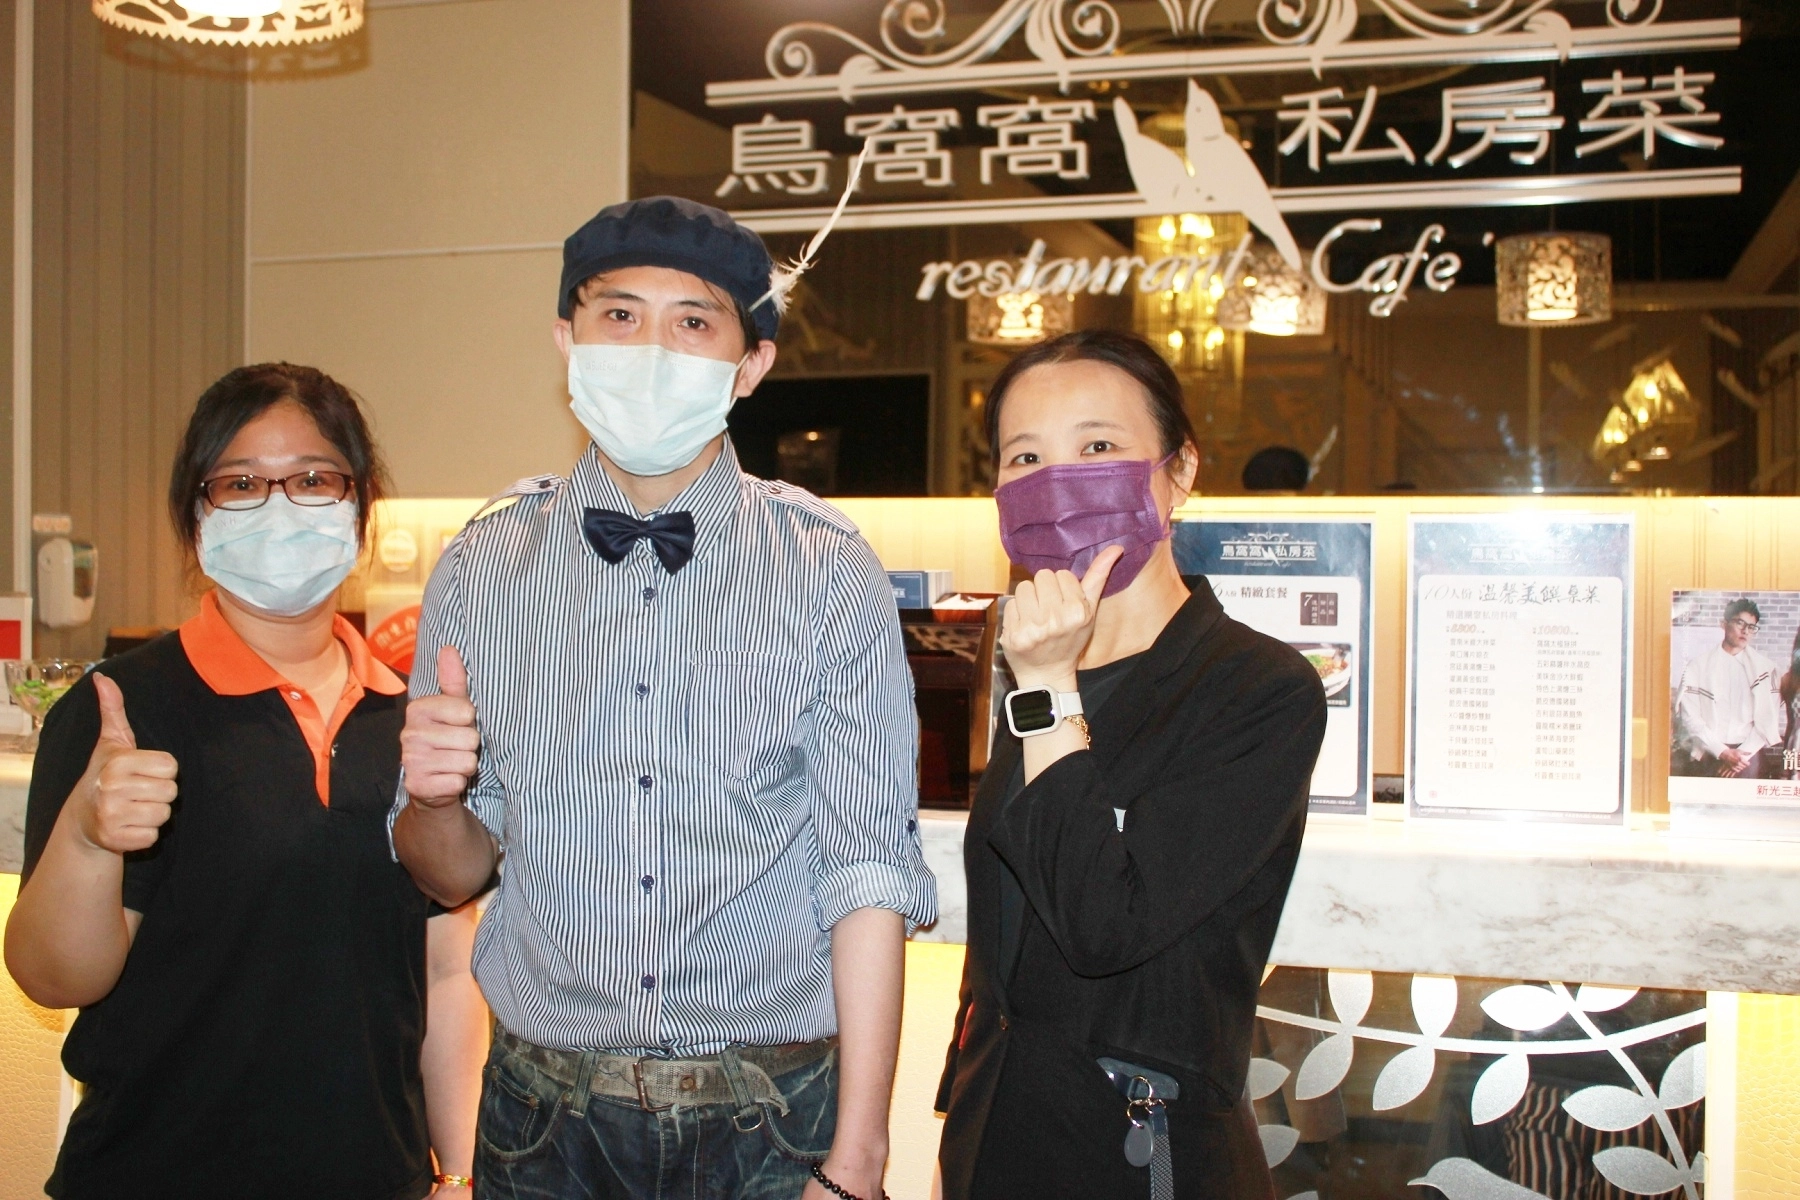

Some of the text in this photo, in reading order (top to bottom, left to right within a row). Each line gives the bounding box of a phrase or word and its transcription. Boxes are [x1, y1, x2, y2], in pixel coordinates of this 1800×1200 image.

[715, 66, 1725, 197] 鳥窩窩 私房菜
[916, 233, 1253, 300] restaurant
[1275, 545, 1316, 558] 私房菜
[1241, 586, 1288, 599] 精緻套餐
[1304, 595, 1313, 607] 7
